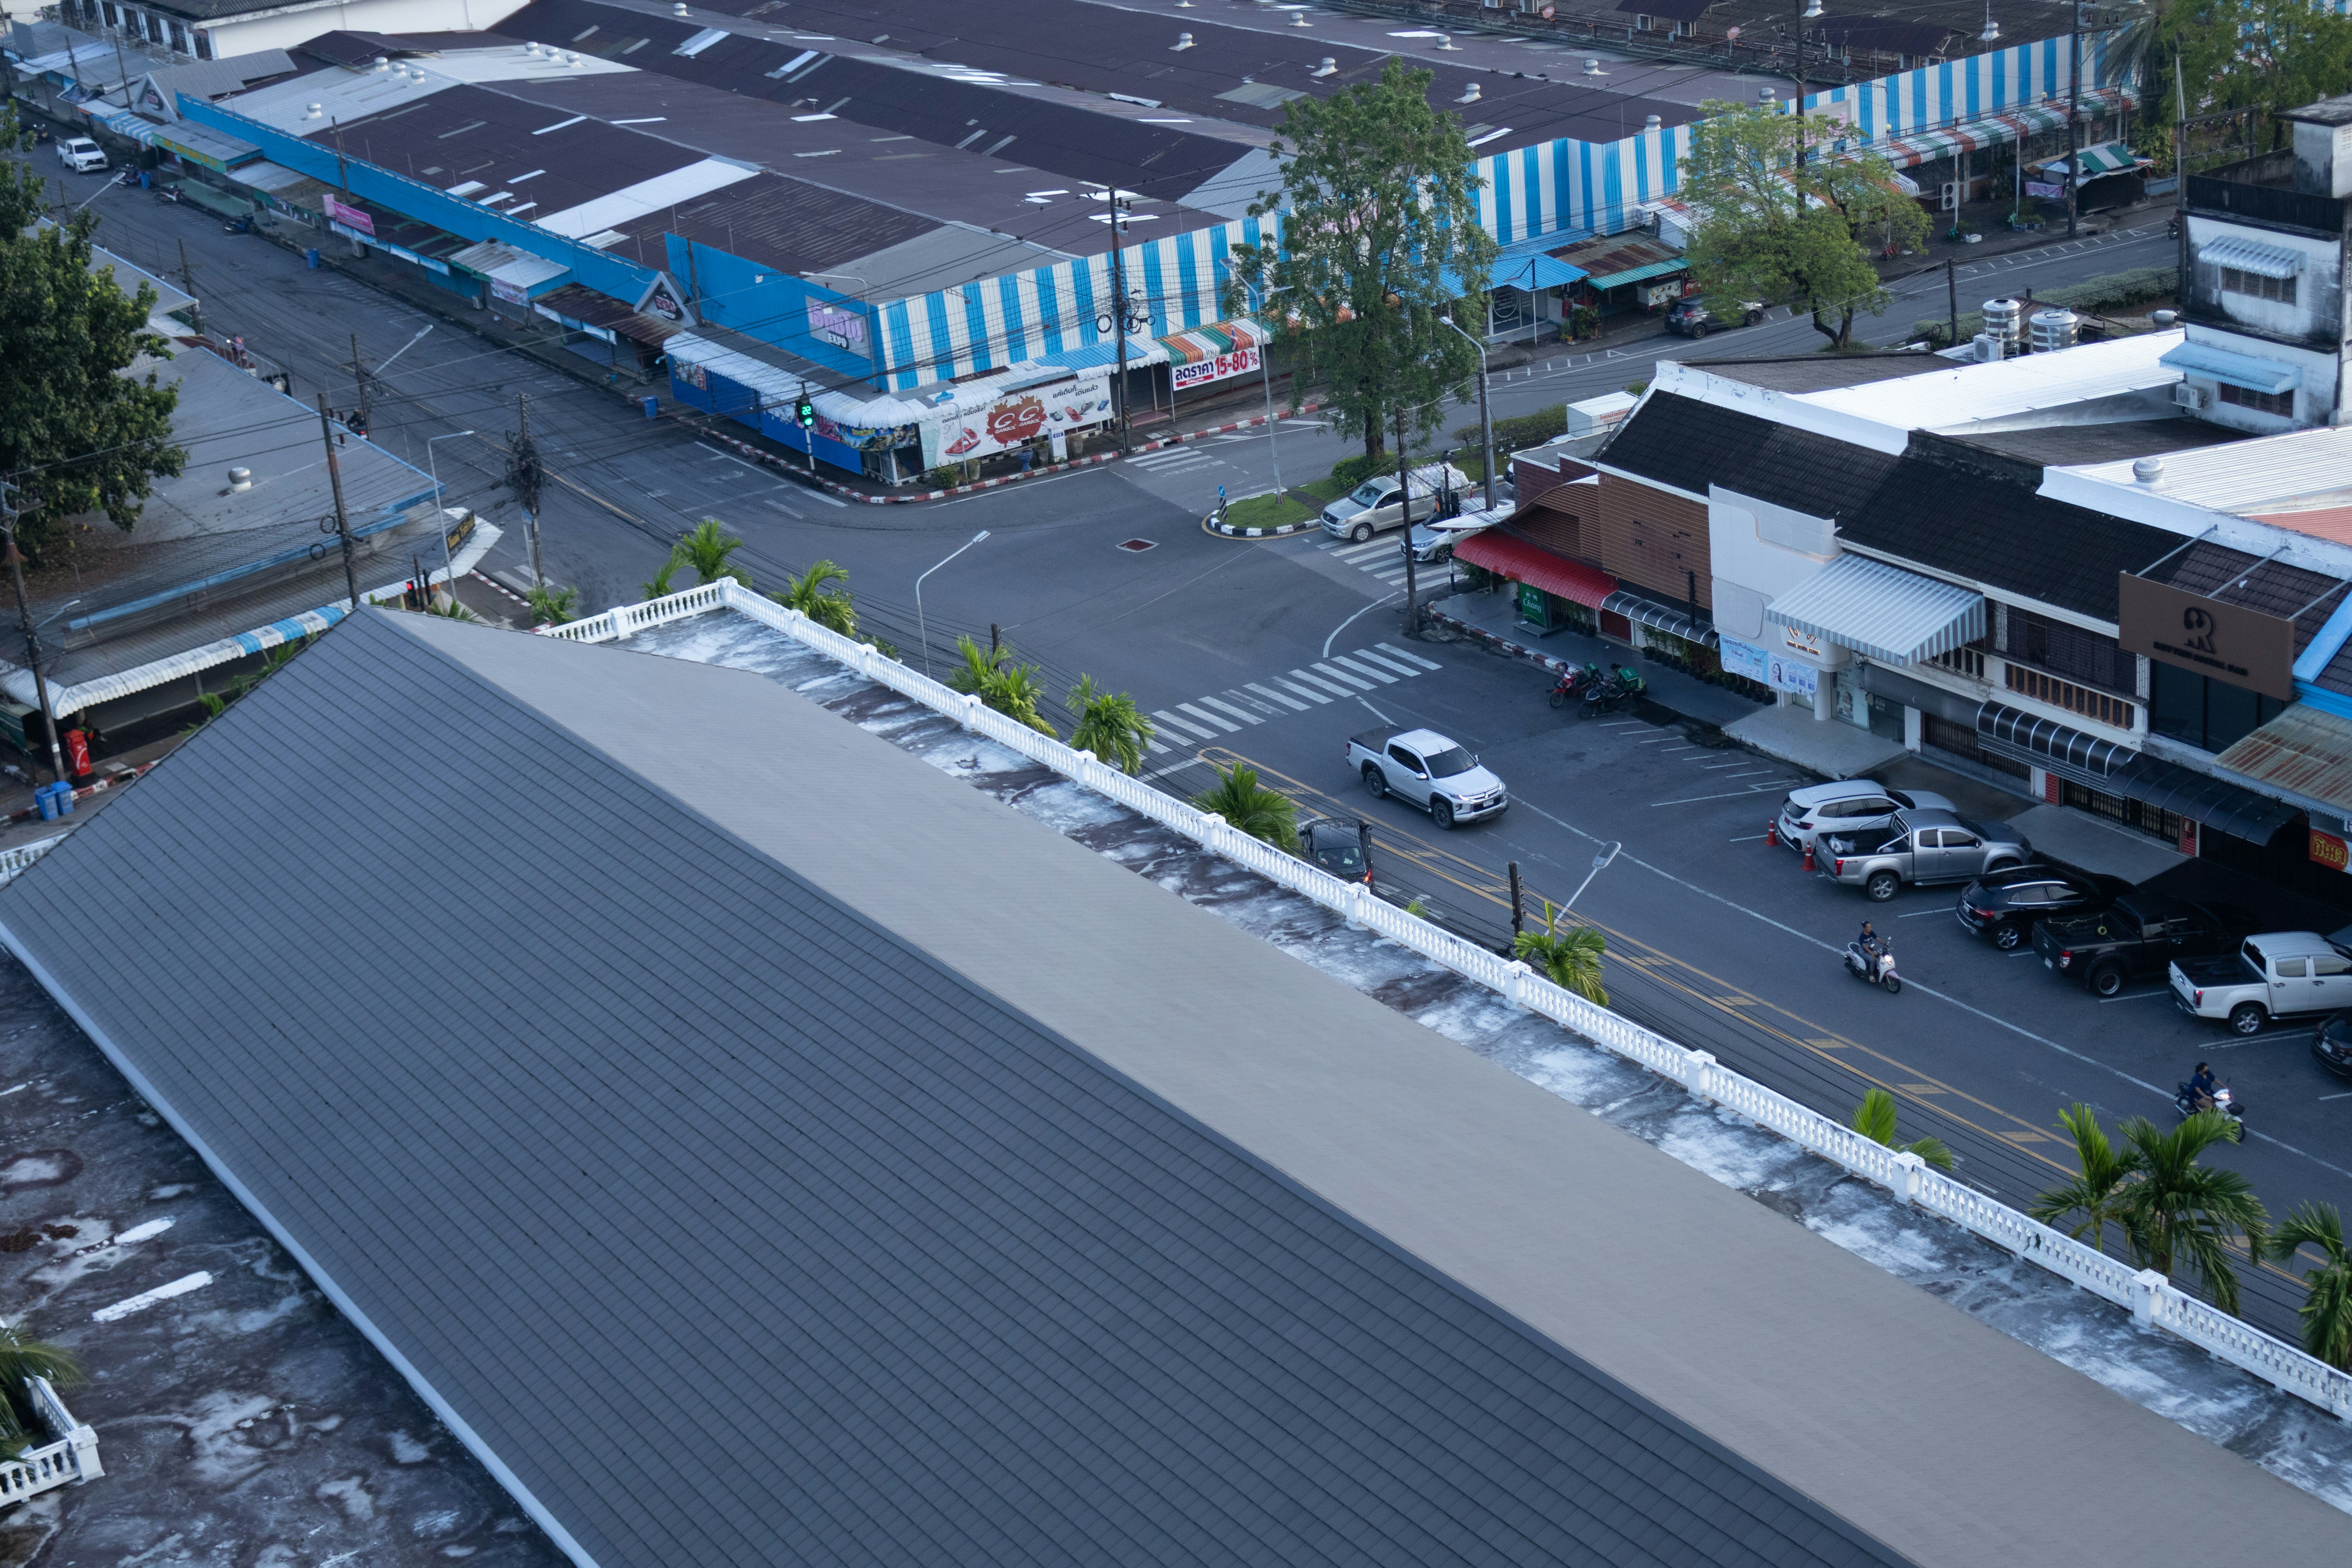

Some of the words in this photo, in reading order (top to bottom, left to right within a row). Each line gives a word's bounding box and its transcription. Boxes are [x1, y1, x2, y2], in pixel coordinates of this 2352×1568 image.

[828, 332, 847, 348] EXPO
[1176, 361, 1214, 380] ลดราคา
[1215, 351, 1247, 376] 15-80
[1250, 352, 1258, 366] %
[802, 405, 811, 415] 22
[1019, 417, 1040, 426] GAMBOL
[995, 425, 1016, 434] GAMBOL
[1523, 598, 1541, 613] Chang
